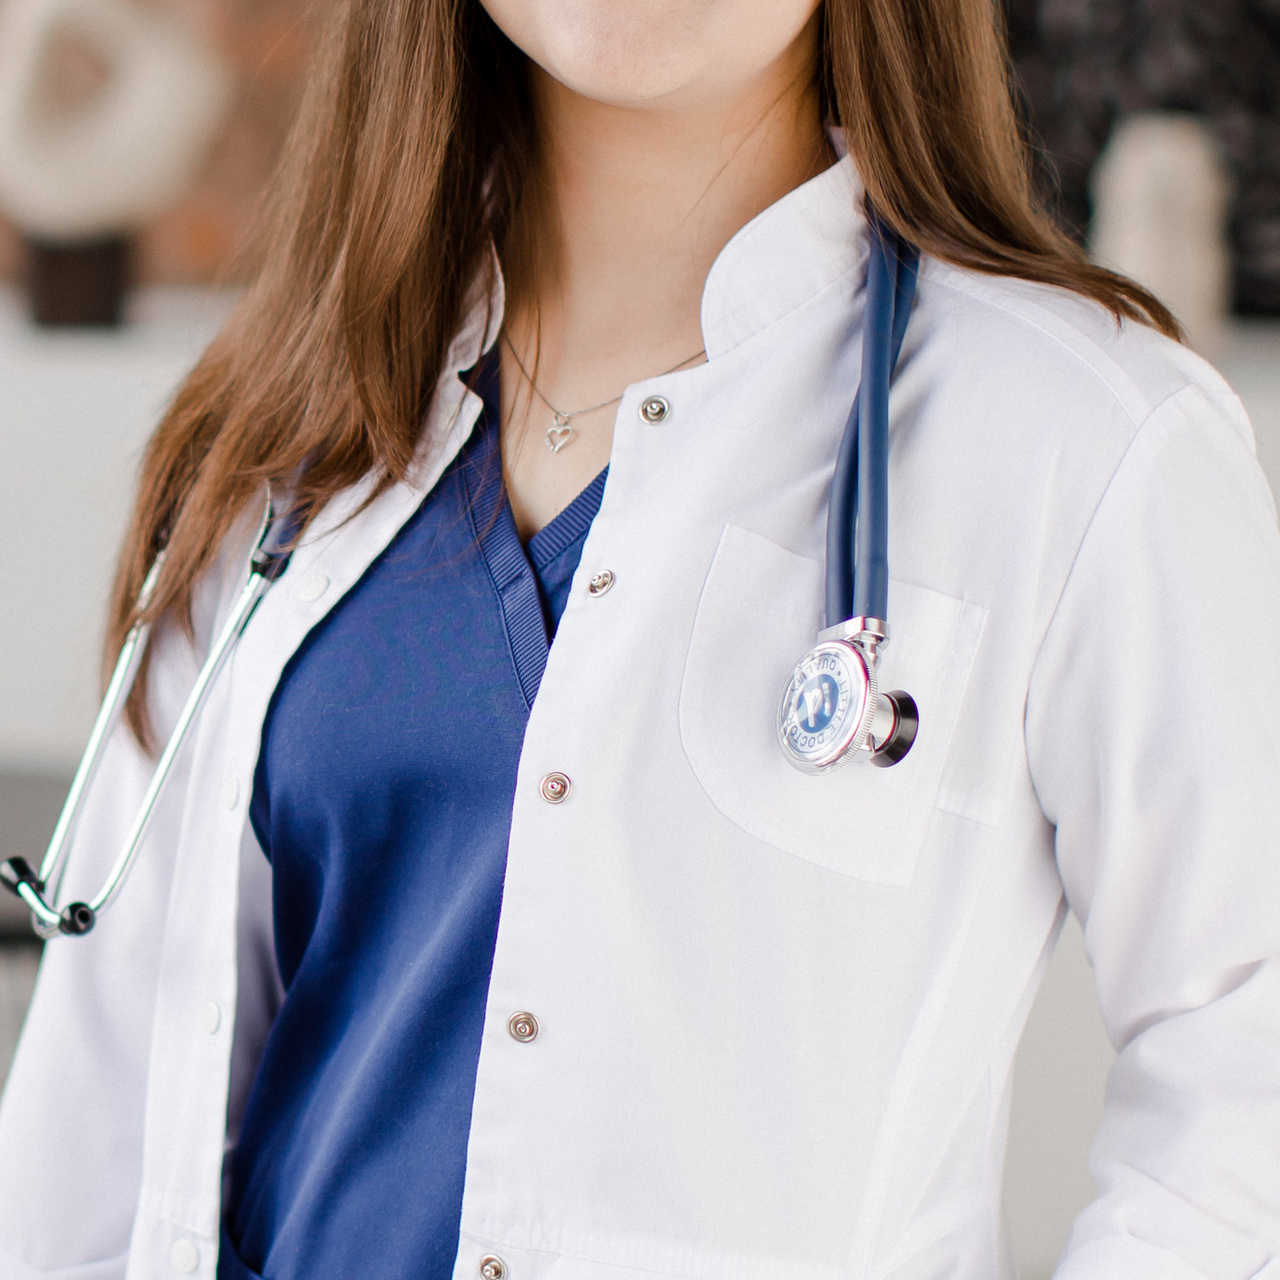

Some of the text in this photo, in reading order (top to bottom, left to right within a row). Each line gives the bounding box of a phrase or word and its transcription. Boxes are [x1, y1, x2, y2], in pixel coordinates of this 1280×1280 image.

[790, 658, 837, 694] QUALITY
[785, 680, 849, 748] LITTLE DOCTOR
